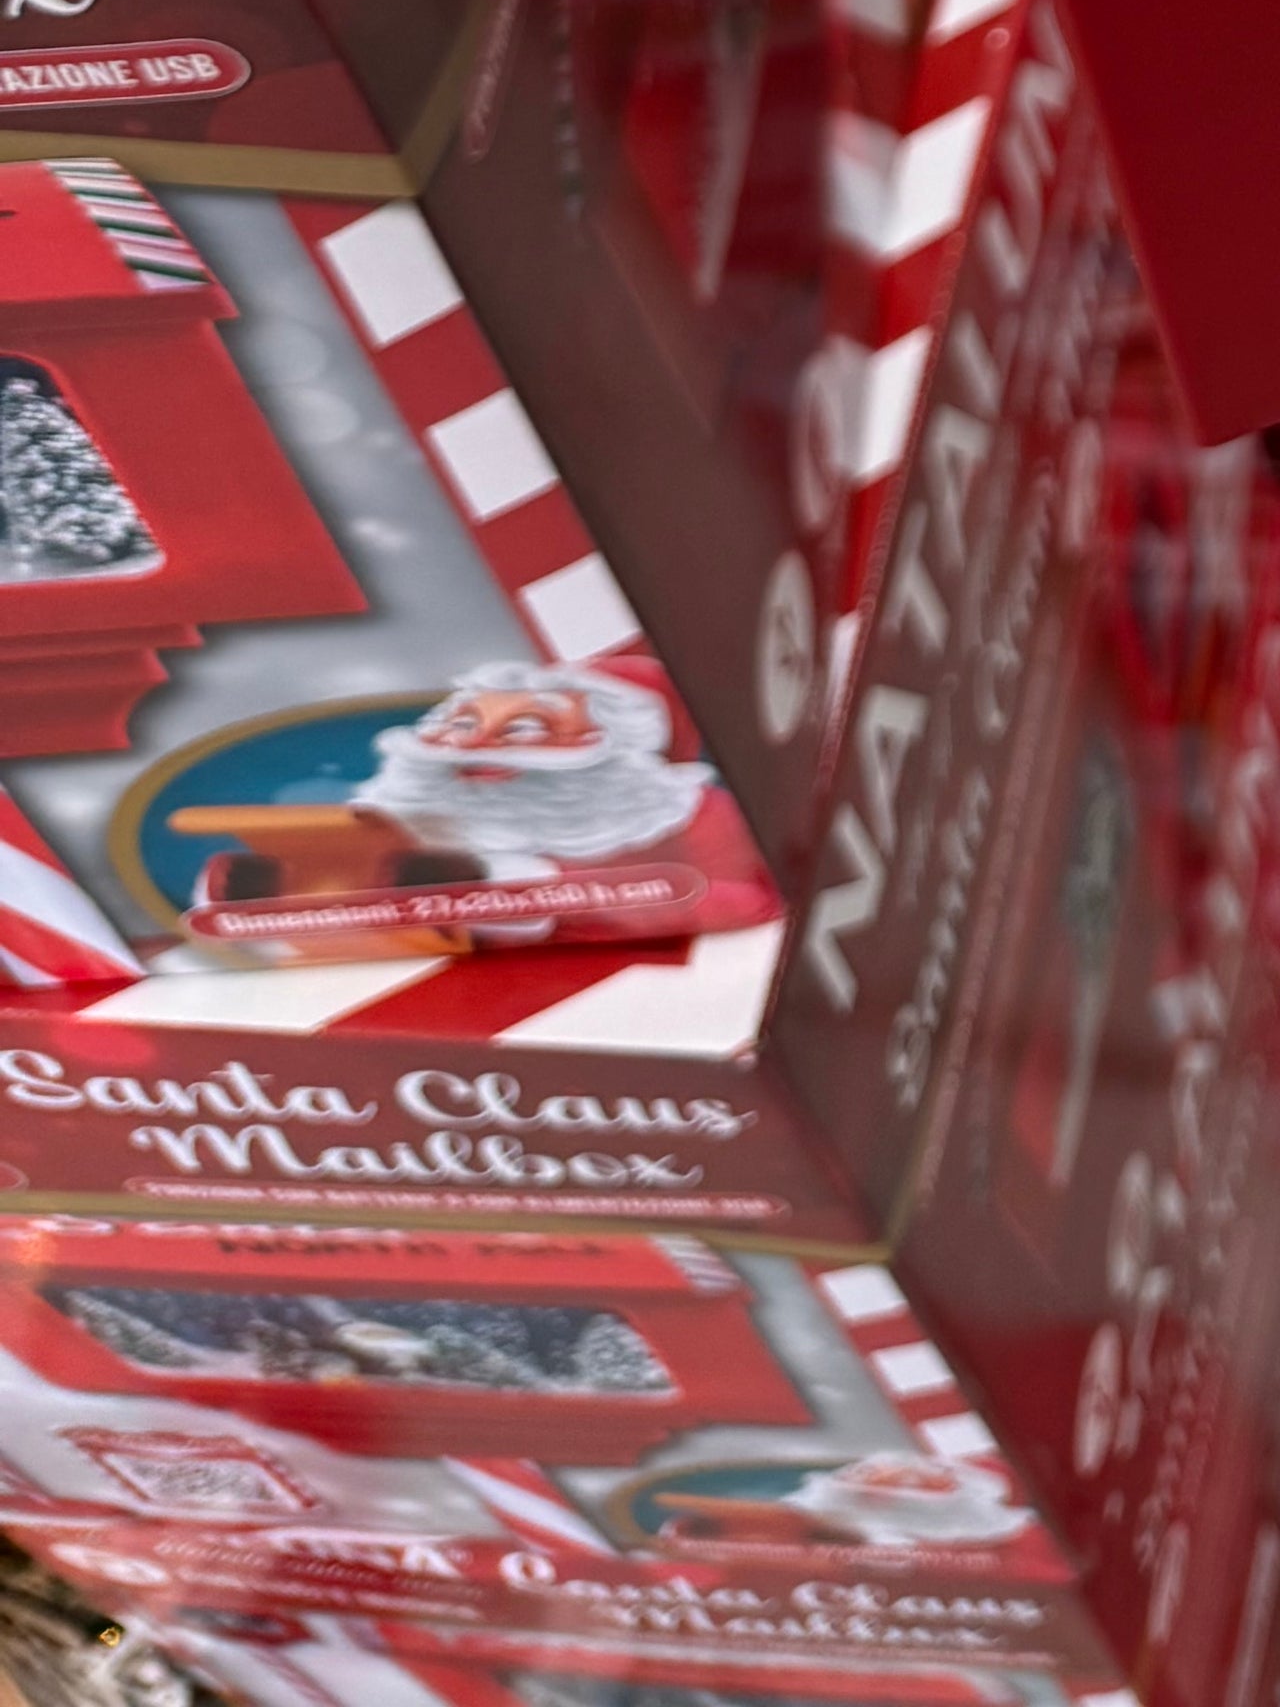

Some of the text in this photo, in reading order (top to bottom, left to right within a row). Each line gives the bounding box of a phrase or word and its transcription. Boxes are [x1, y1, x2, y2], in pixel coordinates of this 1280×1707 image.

[140, 52, 222, 85] USB
[0, 1047, 758, 1140] Santa Claus
[130, 1122, 704, 1189] Mailbox
